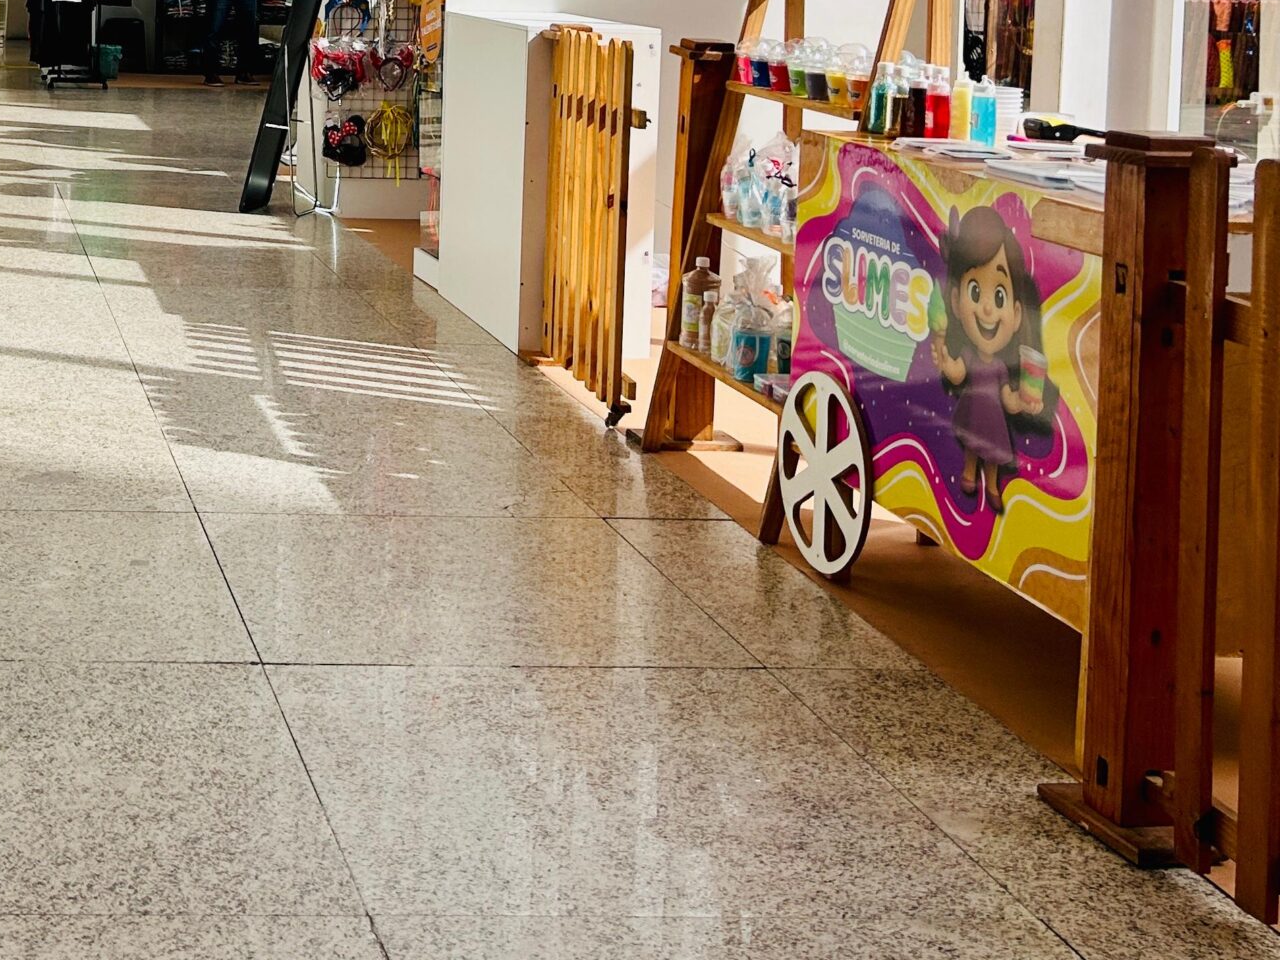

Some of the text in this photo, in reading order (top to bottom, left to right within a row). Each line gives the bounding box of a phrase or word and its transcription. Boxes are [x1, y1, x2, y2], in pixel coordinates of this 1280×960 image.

[852, 227, 901, 254] SORVETERIA DE
[823, 239, 932, 339] SLIMES
